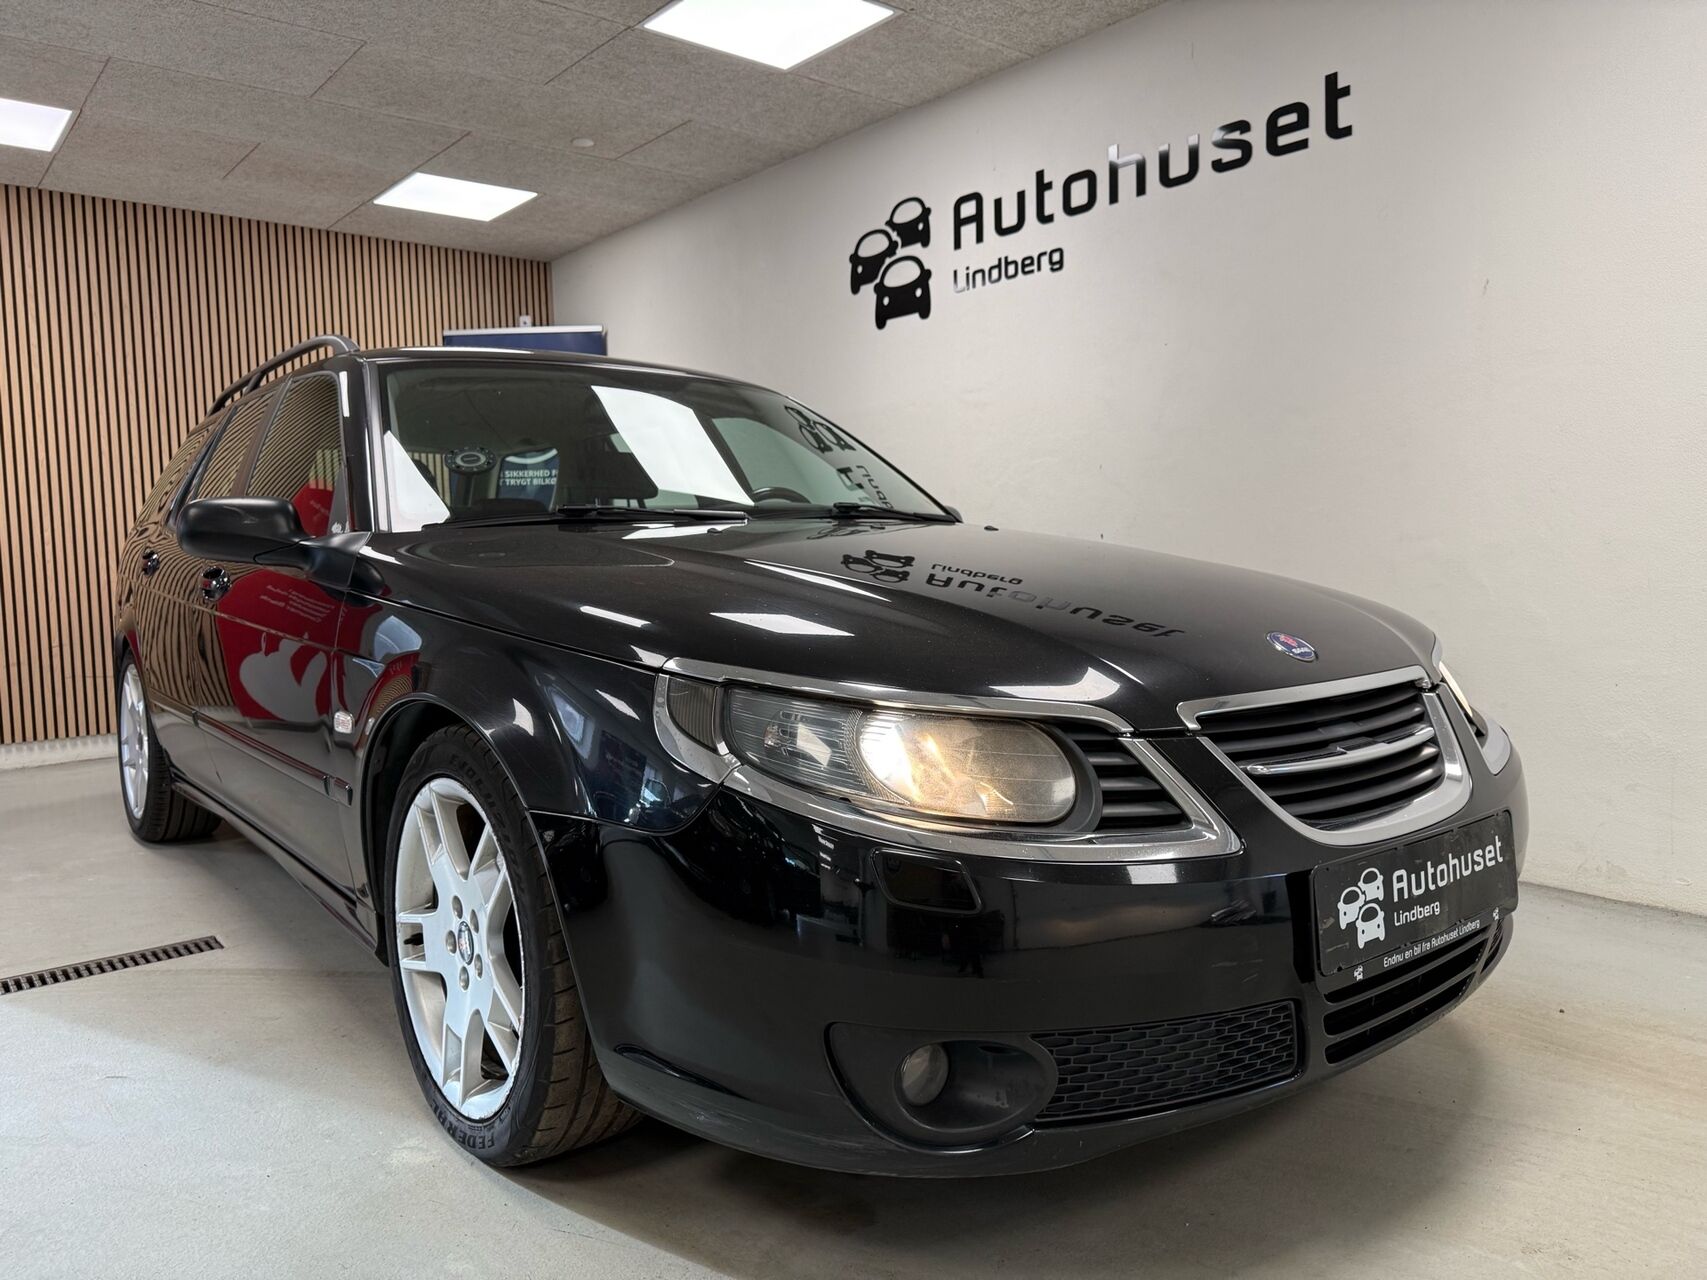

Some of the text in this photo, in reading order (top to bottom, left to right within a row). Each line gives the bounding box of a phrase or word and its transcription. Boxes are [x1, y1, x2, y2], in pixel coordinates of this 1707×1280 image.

[953, 71, 1353, 251] Autohuset
[953, 247, 1064, 293] Lindberg
[505, 469, 550, 478] SIKKERHED
[505, 477, 531, 487] TRYGT
[1392, 835, 1504, 903] Autohuset
[1393, 901, 1441, 926] Lindberg
[1383, 919, 1481, 968] Endnu en bil fra Autohuset Lindberg
[430, 1098, 496, 1150] FEDERAL
